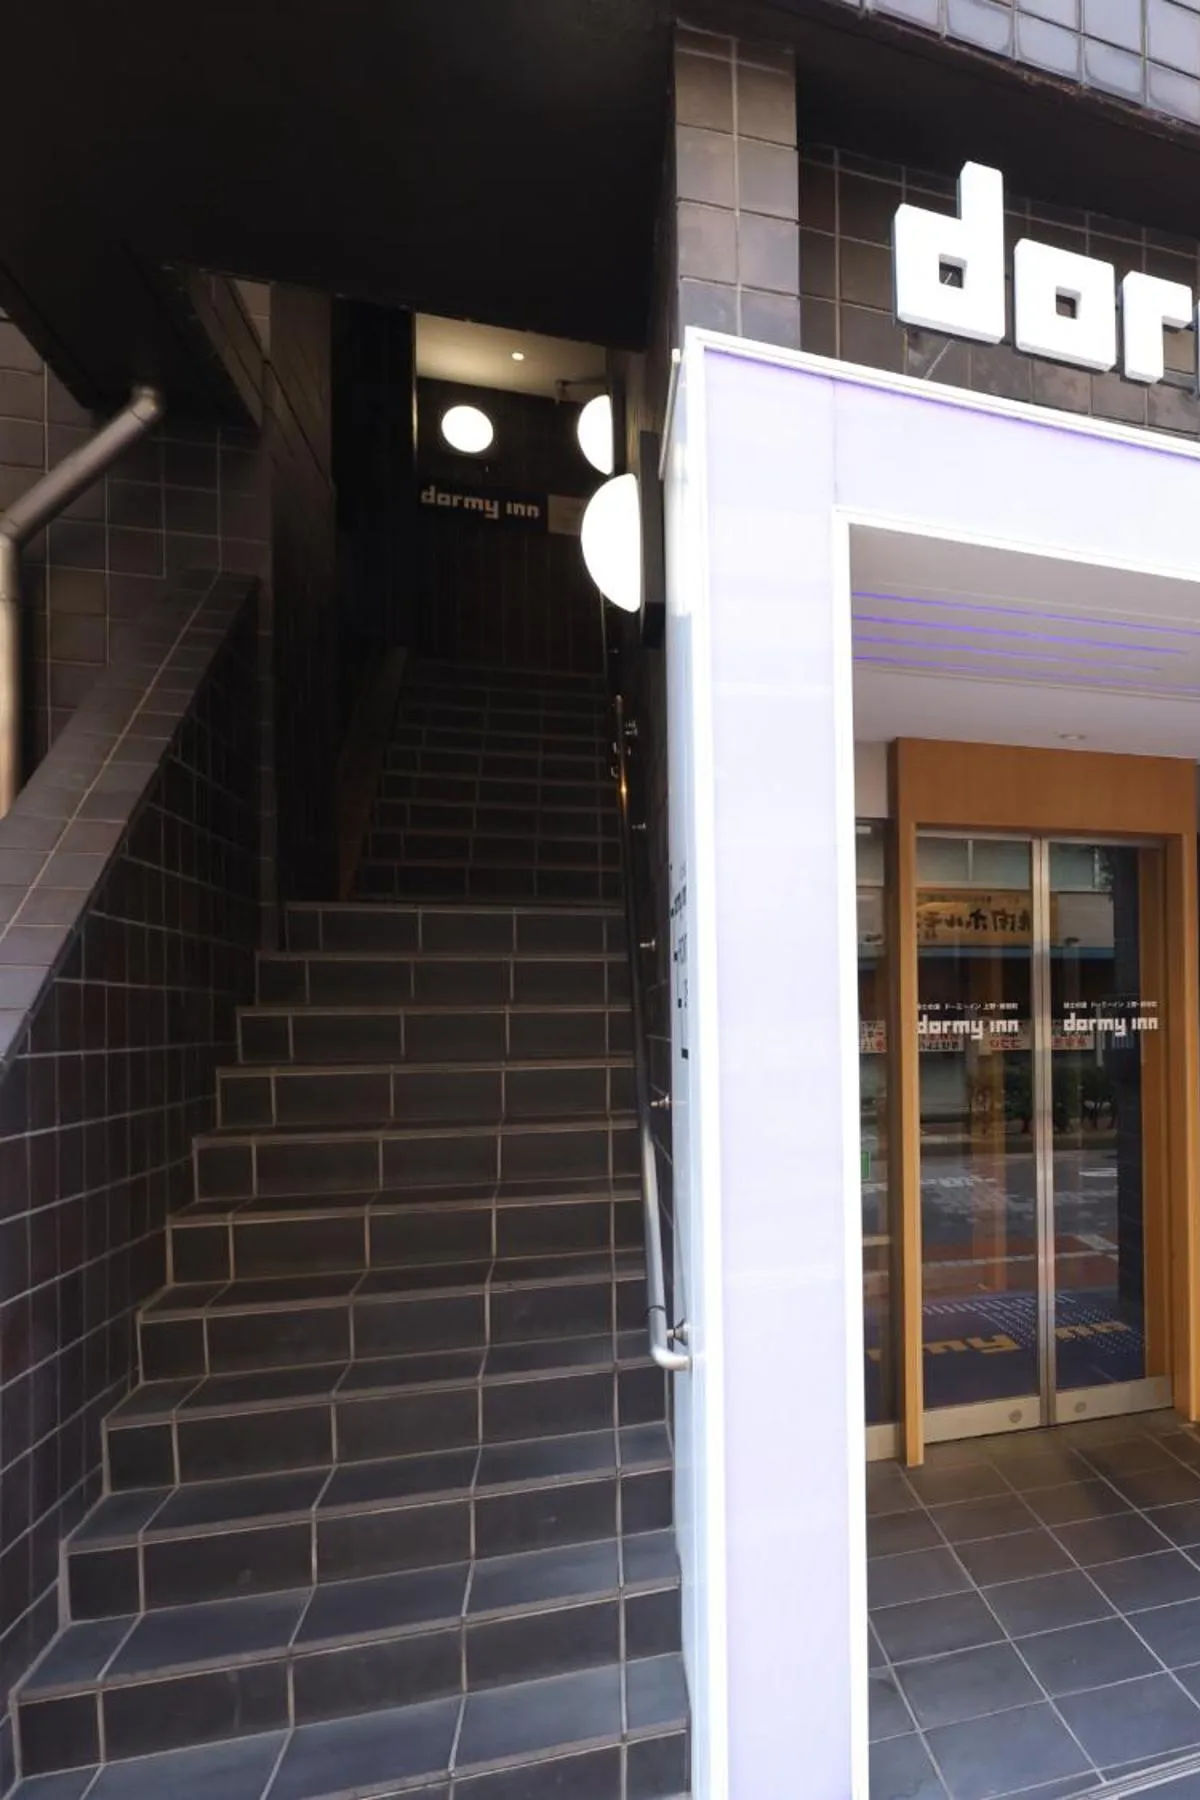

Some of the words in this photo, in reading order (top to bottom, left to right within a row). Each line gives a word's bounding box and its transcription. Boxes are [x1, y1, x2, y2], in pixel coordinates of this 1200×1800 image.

[421, 485, 499, 519] dormy
[506, 501, 540, 518] inn
[917, 1013, 983, 1040] dormy
[990, 1020, 1019, 1033] inn
[1063, 1012, 1126, 1037] dormy
[1131, 1017, 1158, 1030] inn
